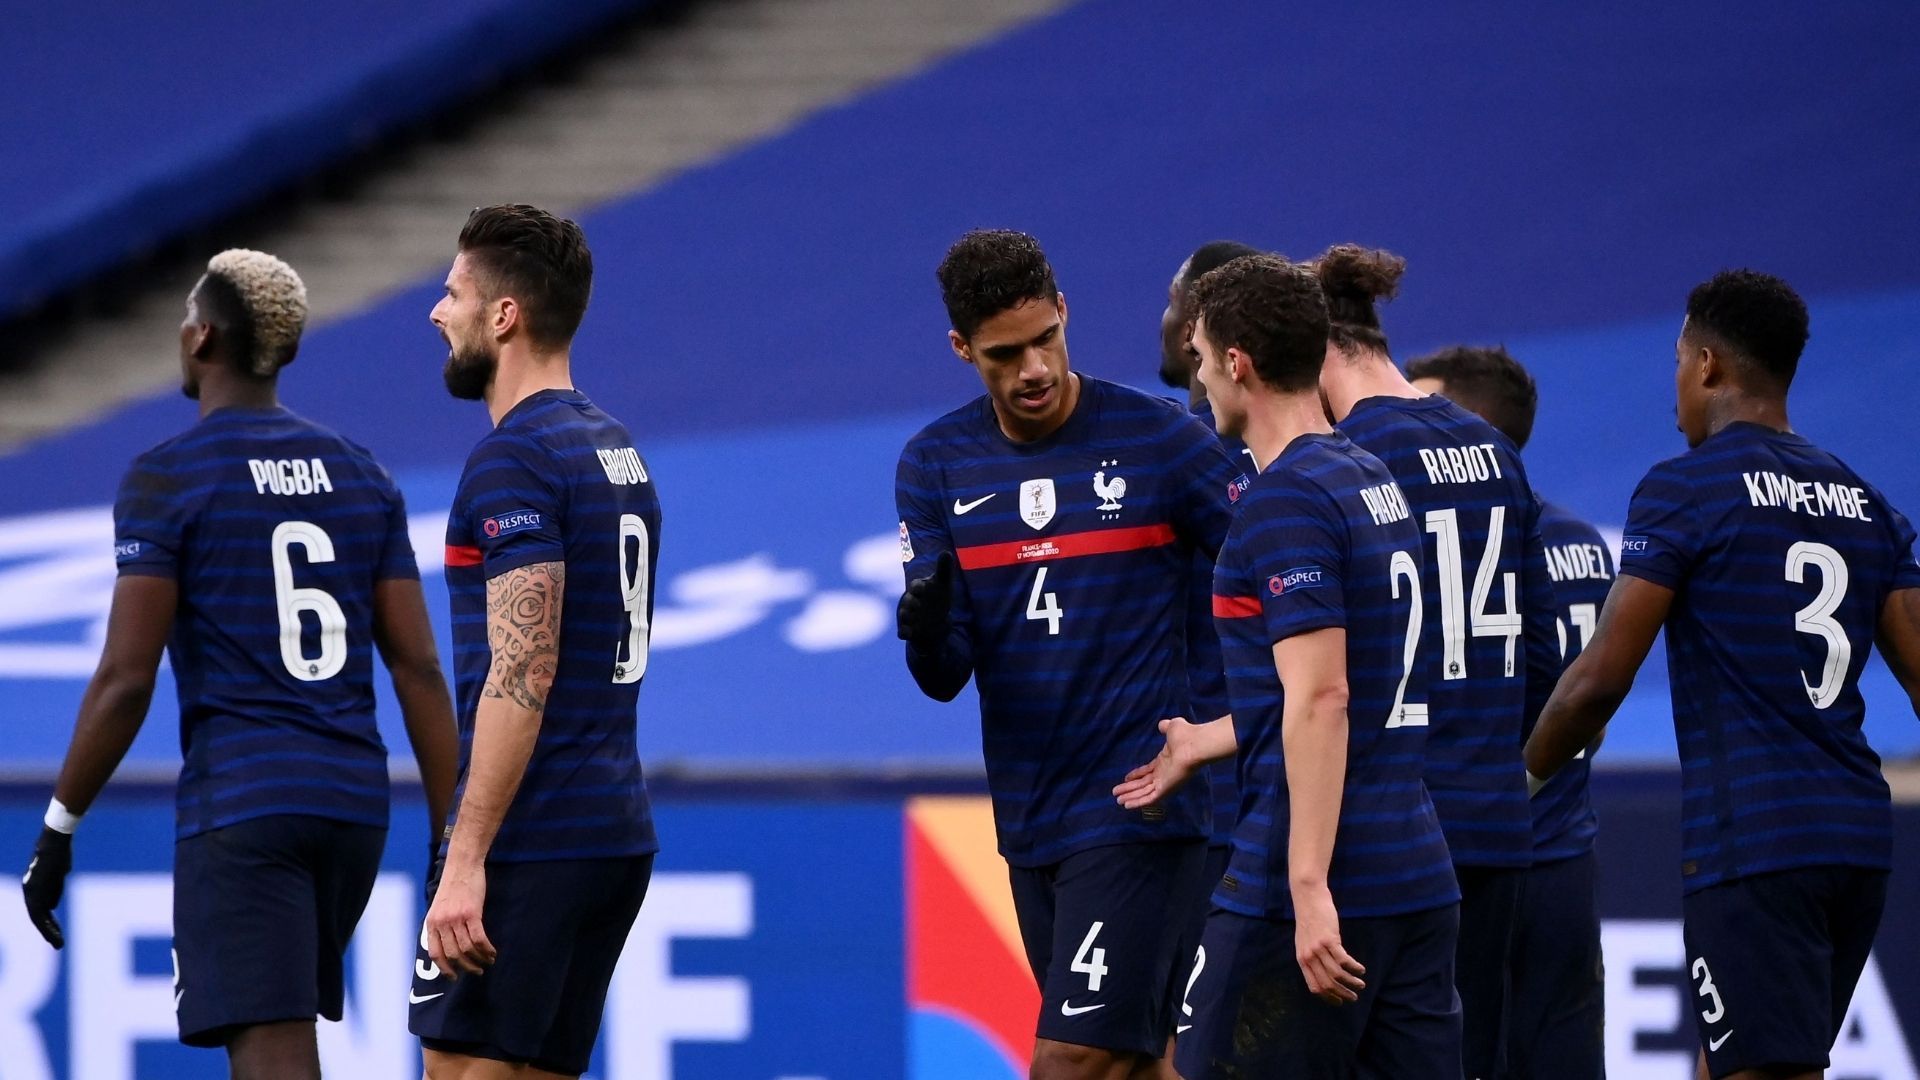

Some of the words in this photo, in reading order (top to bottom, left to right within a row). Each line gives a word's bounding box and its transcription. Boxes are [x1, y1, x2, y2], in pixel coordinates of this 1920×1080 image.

[248, 457, 333, 496] POGBA
[1418, 443, 1501, 485] RABIOT
[1742, 470, 1872, 523] KIMPEMBE
[499, 514, 541, 530] RESPECT
[271, 520, 348, 682] 6
[612, 513, 651, 684] 9
[1026, 566, 1063, 635] 4
[1283, 571, 1322, 588] RESPECT
[1426, 505, 1522, 681] 14
[1385, 550, 1429, 729] 2
[1785, 541, 1852, 709] 3
[1070, 920, 1109, 992] 4
[1692, 956, 1725, 1024] 3
